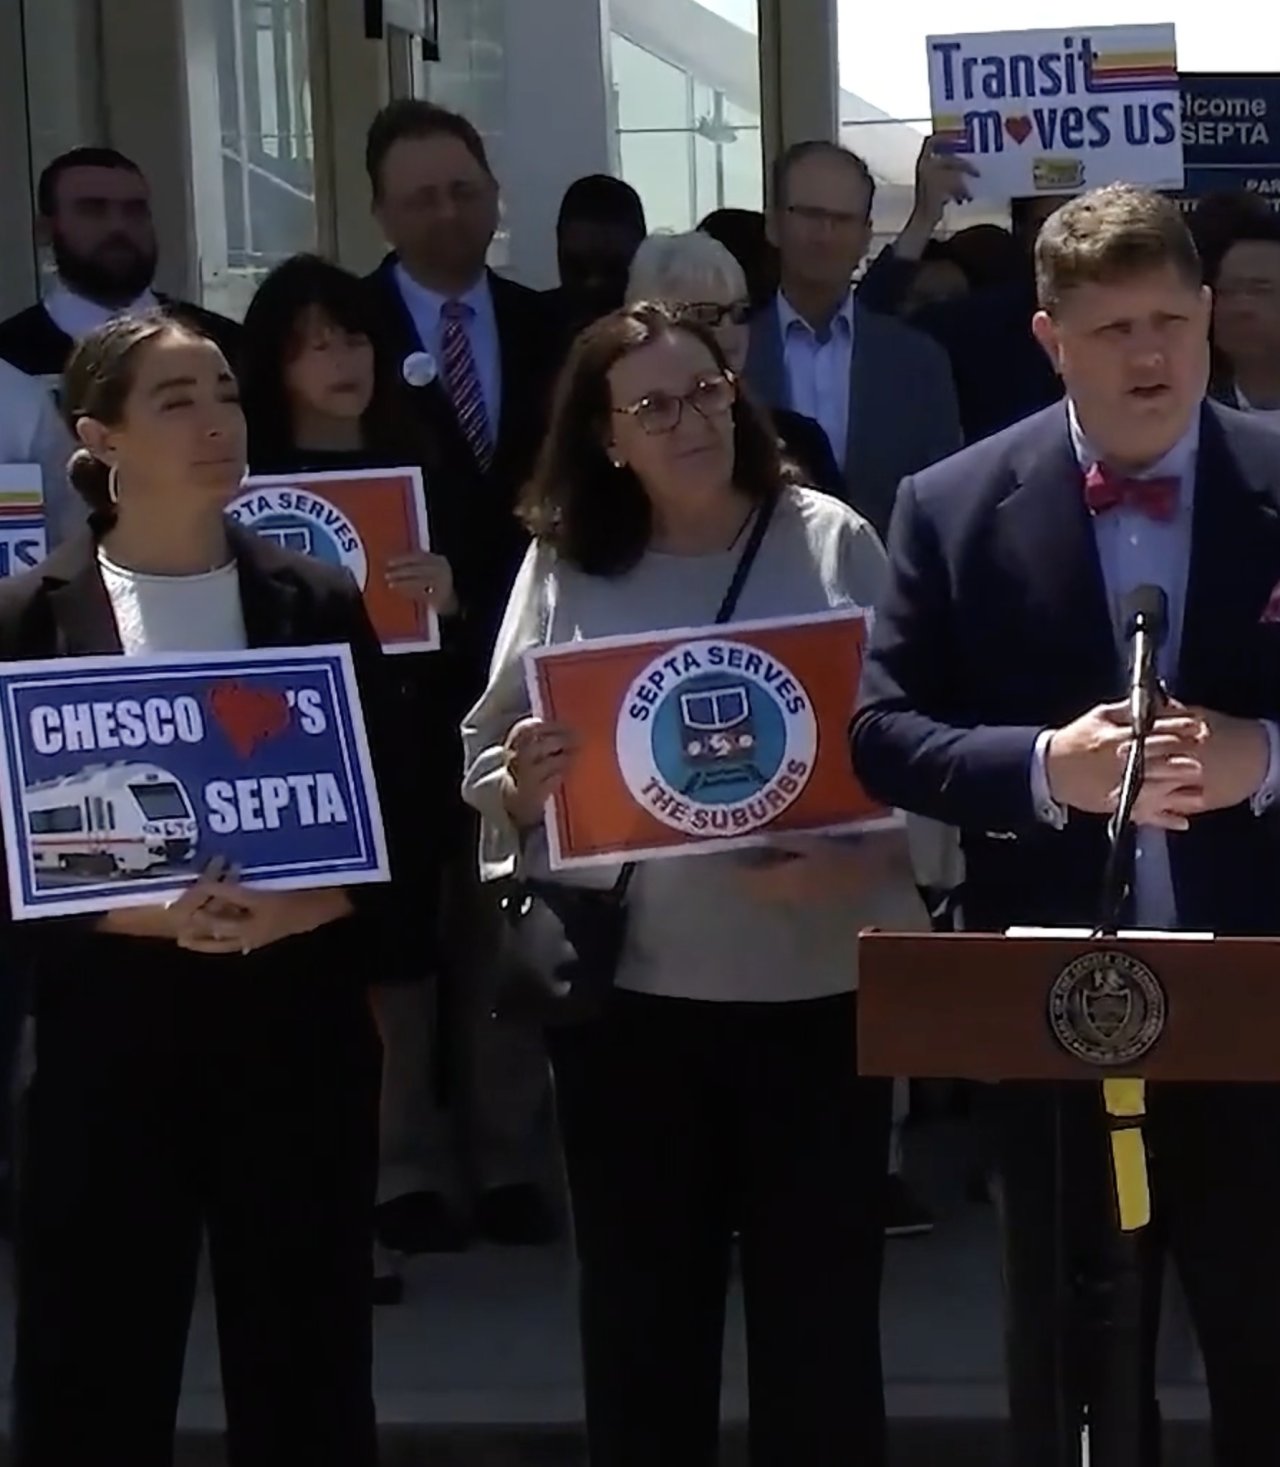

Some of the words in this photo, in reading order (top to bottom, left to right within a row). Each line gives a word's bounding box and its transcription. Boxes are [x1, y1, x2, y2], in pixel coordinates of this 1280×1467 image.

[932, 36, 1098, 101] Transit
[1123, 102, 1176, 146] us
[1180, 92, 1267, 117] lcome
[1181, 121, 1270, 145] SEPTA
[278, 492, 359, 553] SERVES
[629, 651, 702, 722] SEPTA
[707, 646, 806, 716] SERVES
[30, 695, 205, 756] CHESCO
[204, 772, 349, 836] SEPTA
[641, 776, 690, 823] THE
[691, 758, 808, 830] SUBURBS
